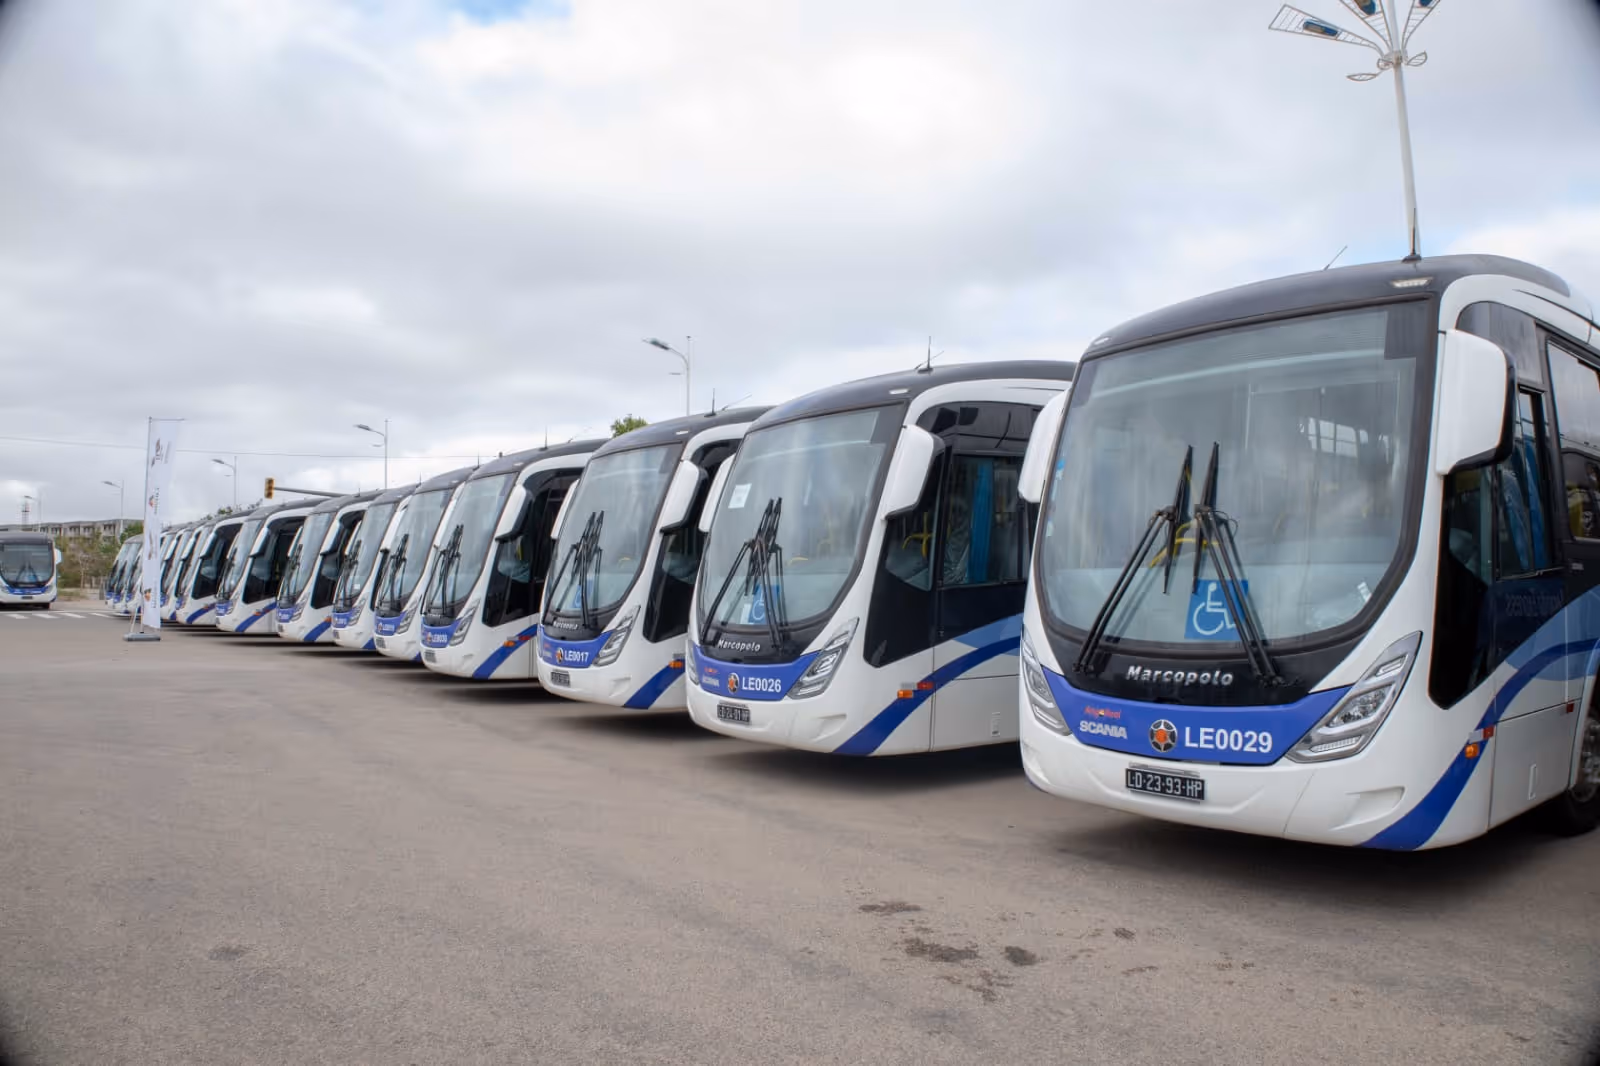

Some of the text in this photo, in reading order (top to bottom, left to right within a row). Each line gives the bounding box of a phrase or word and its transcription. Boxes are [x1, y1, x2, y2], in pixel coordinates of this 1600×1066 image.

[718, 639, 761, 652] Marcopolo
[741, 676, 782, 693] LE0026
[1126, 665, 1234, 686] Marcopolo
[1079, 720, 1128, 740] SCANIA
[1184, 726, 1273, 754] LE0029
